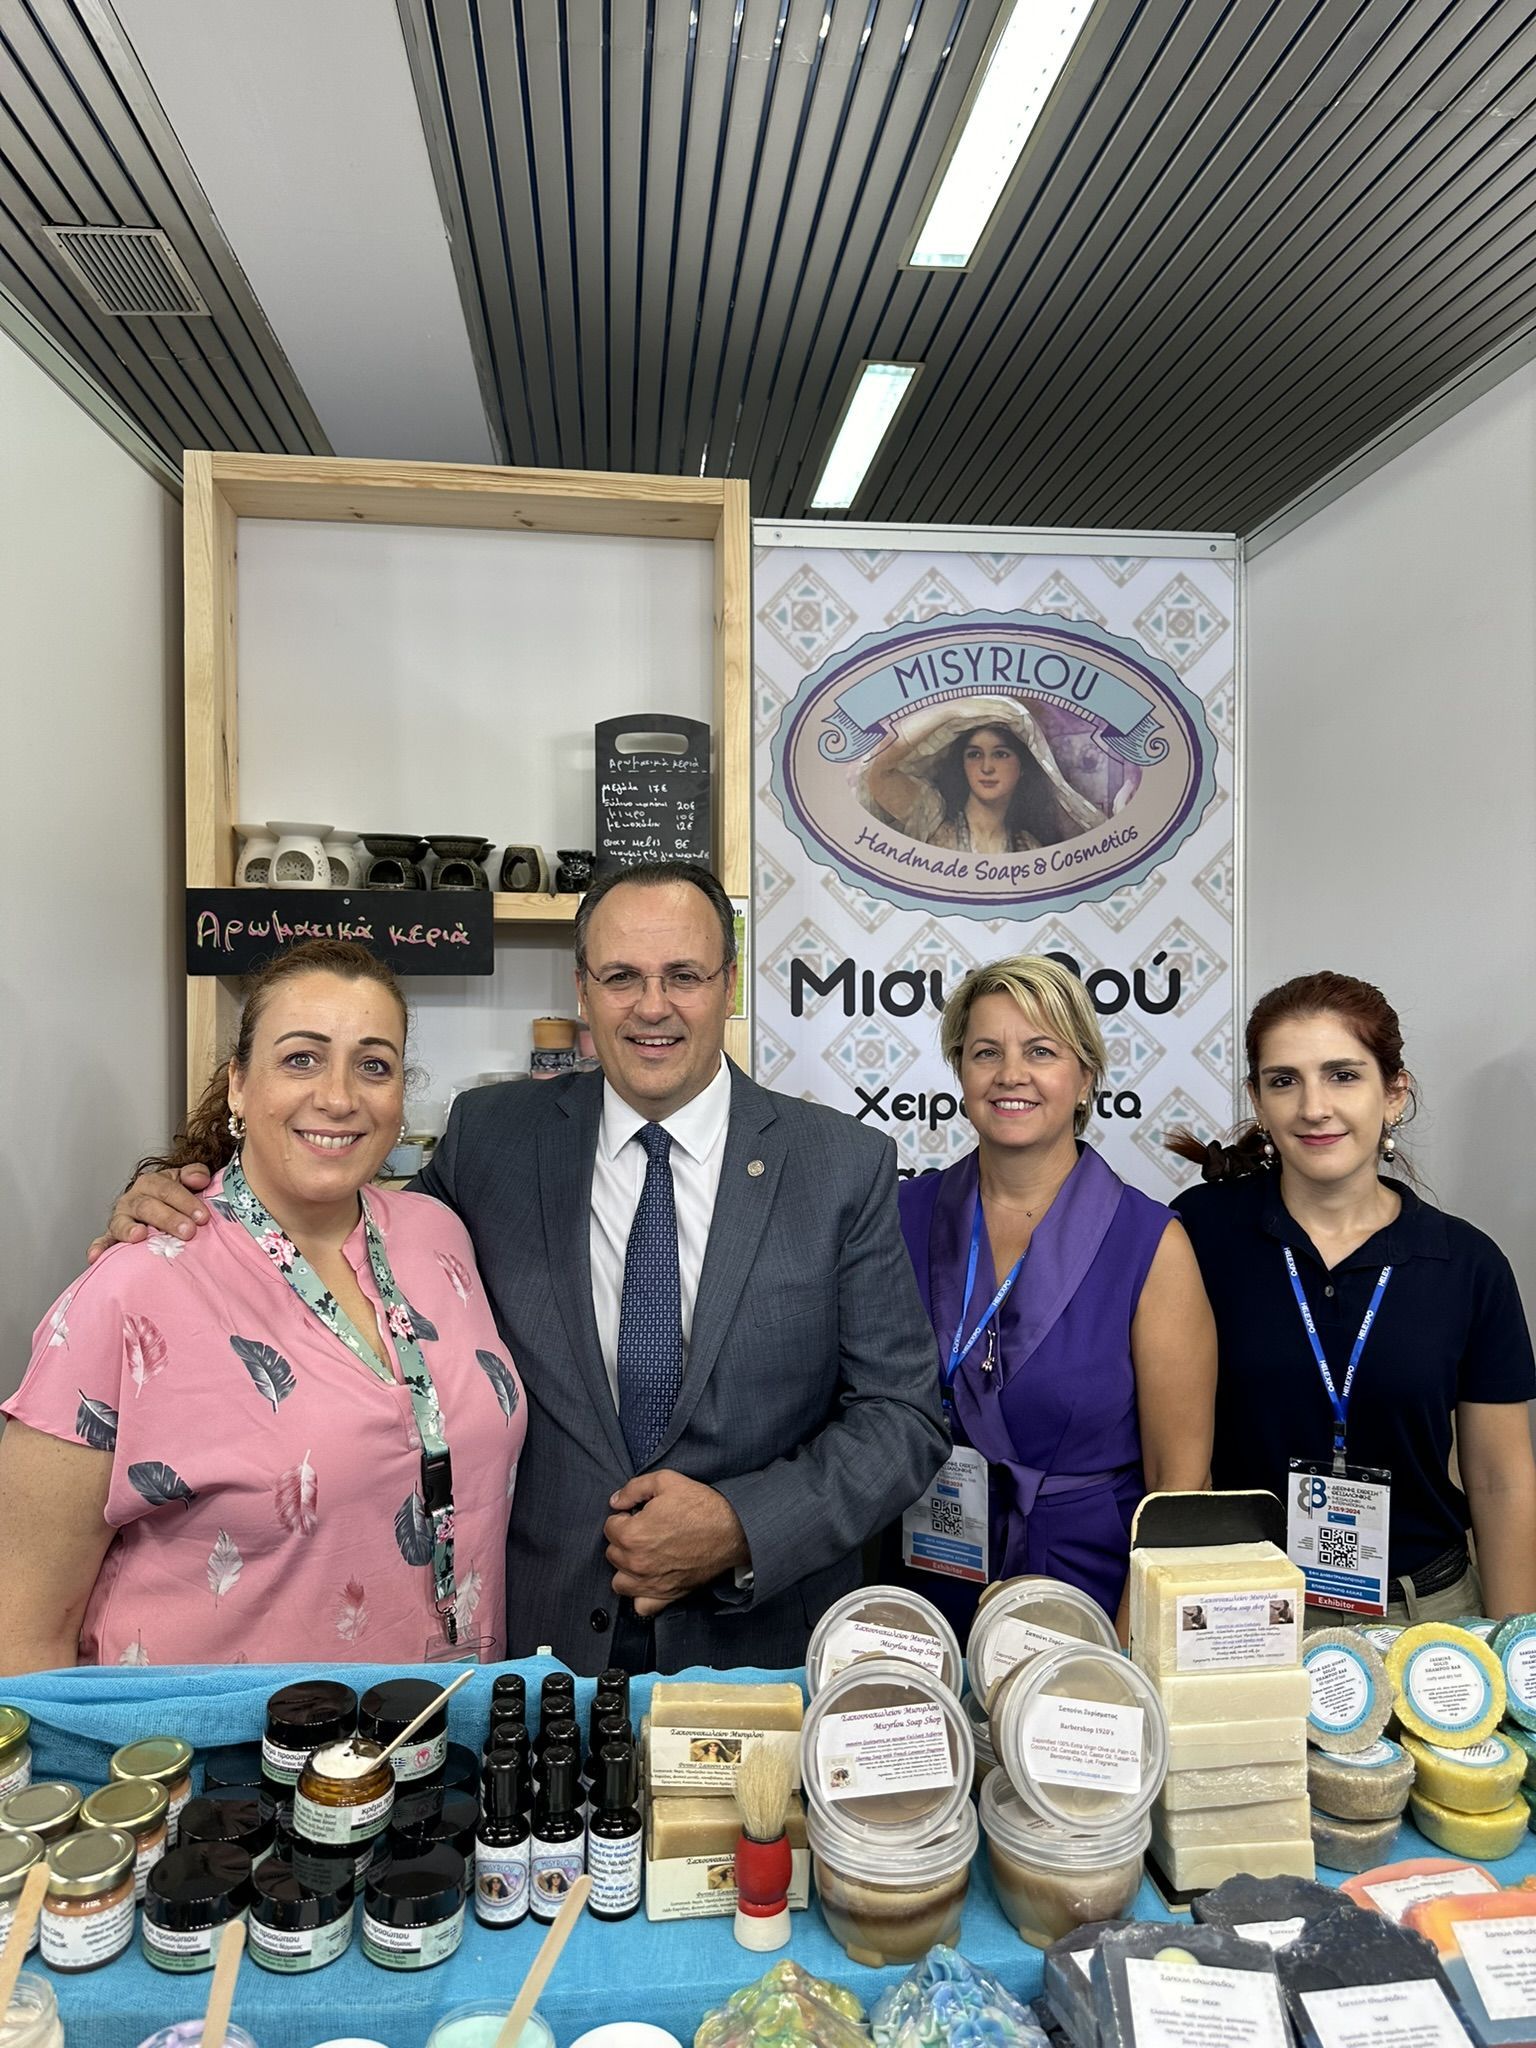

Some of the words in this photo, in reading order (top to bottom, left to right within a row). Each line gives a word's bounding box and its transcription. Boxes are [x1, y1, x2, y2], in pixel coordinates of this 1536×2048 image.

[892, 646, 1100, 702] MISYRLOU
[676, 801, 695, 810] 20€
[676, 813, 694, 821] 10€
[676, 822, 693, 831] 12€
[674, 839, 690, 849] 8€
[855, 827, 969, 878] Handmade
[975, 860, 1030, 886] Soaps
[1033, 857, 1046, 875] &
[1050, 825, 1138, 871] Cosmetics
[197, 910, 375, 951] Αρωματικά
[389, 922, 470, 948] κεριά
[992, 1279, 1012, 1307] HELEXPO
[1300, 1302, 1316, 1334] HELEXPO
[1357, 1310, 1374, 1340] HELEXPO
[1320, 1360, 1335, 1392] HELEXPO
[1342, 1365, 1355, 1397] HELEXPO
[1318, 1597, 1355, 1609] Exhibitor
[906, 1718, 923, 1728] Soap
[924, 1715, 941, 1726] Shop
[371, 1923, 410, 1939] προσώπου
